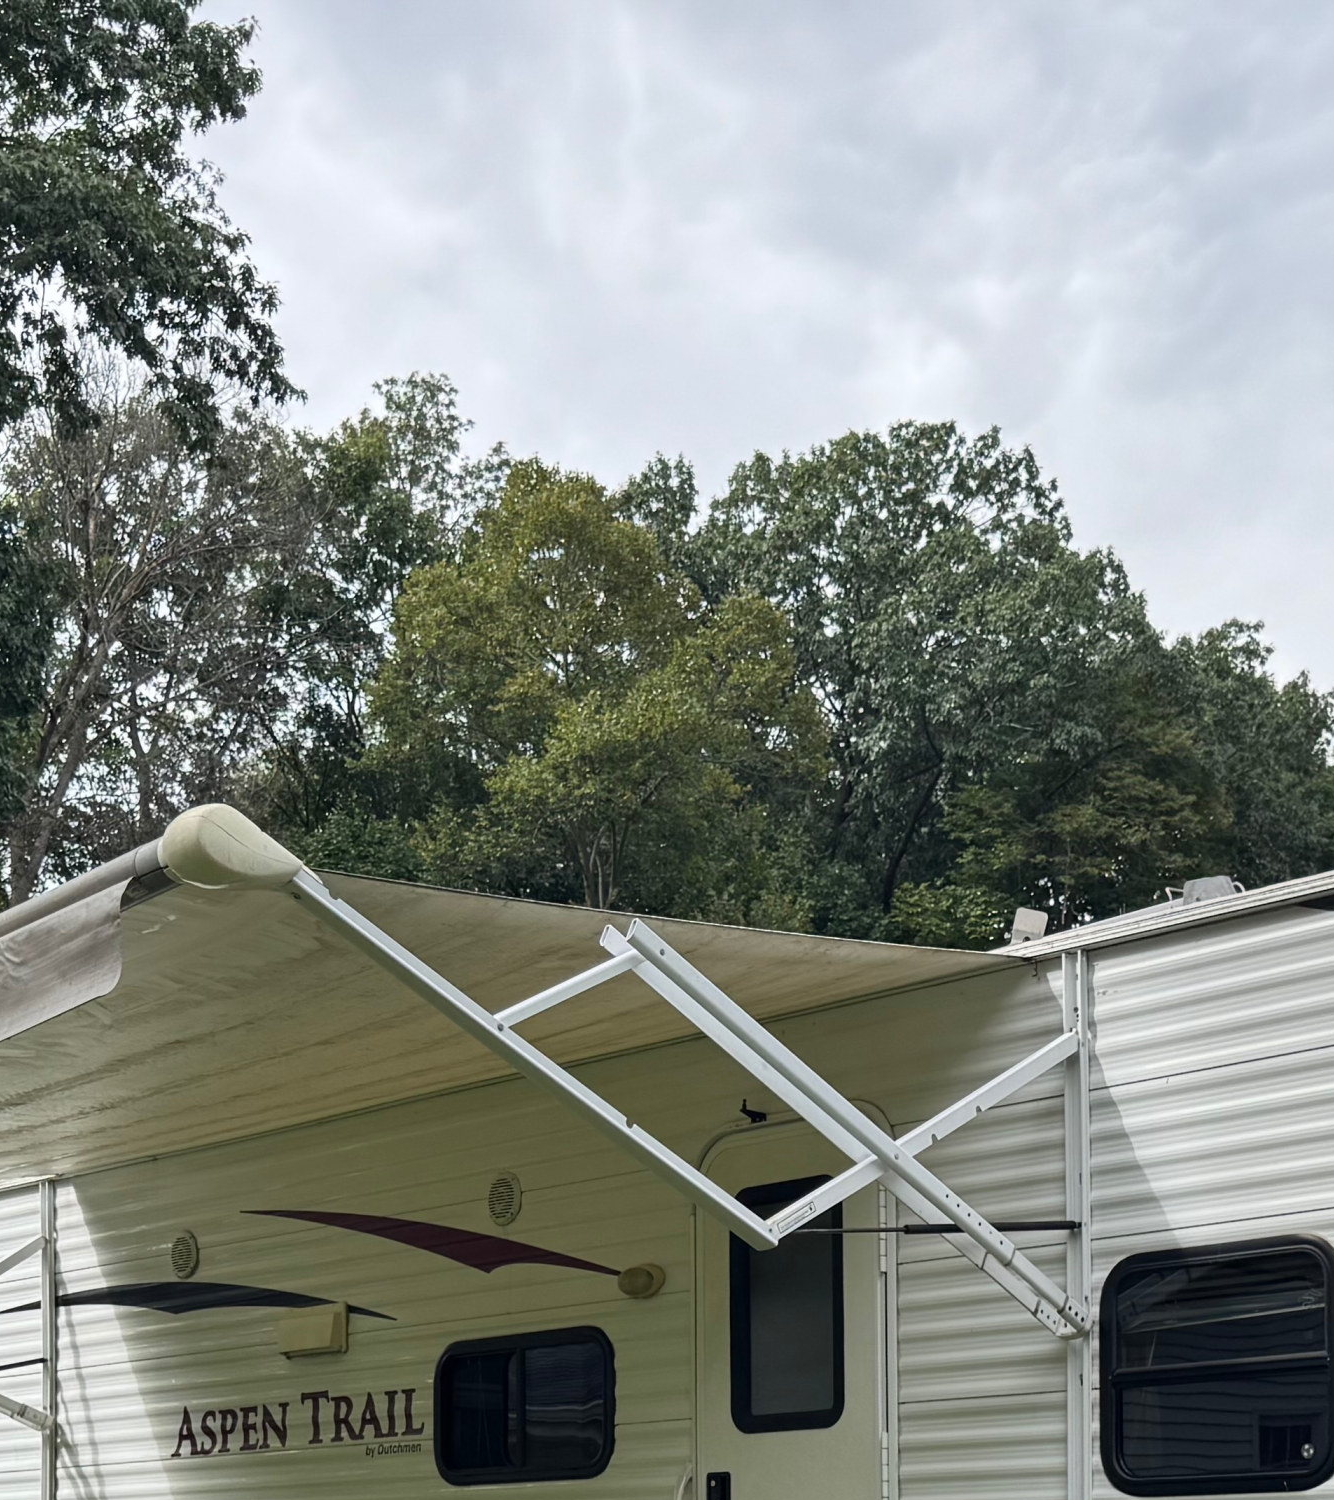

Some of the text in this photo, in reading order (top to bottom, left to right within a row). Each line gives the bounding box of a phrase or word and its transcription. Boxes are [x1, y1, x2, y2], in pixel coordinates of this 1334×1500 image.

[171, 1388, 424, 1457] ASPEN TRAIL
[365, 1443, 422, 1458] by Dutchmen
